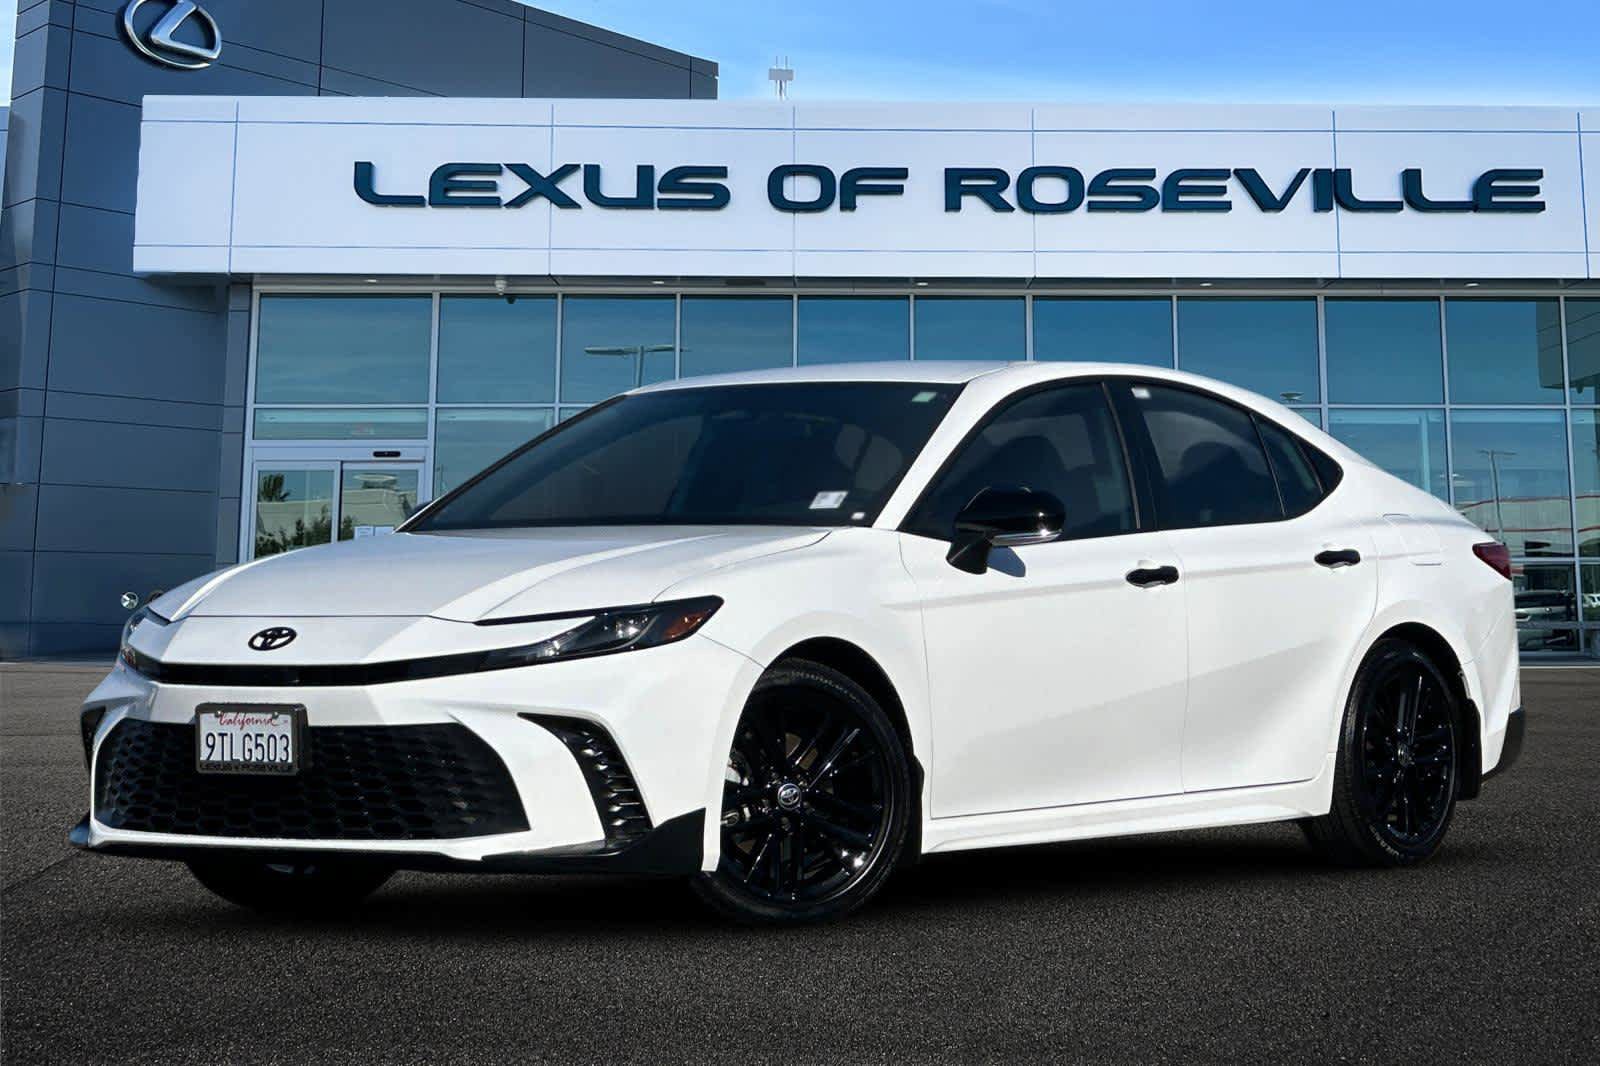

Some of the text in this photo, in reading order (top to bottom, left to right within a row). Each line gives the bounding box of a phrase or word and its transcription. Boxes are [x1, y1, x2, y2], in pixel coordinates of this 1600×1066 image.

[353, 161, 1545, 214] LEXUS OF ROSEVILLE
[218, 711, 279, 731] California
[205, 732, 290, 763] 9TLG503
